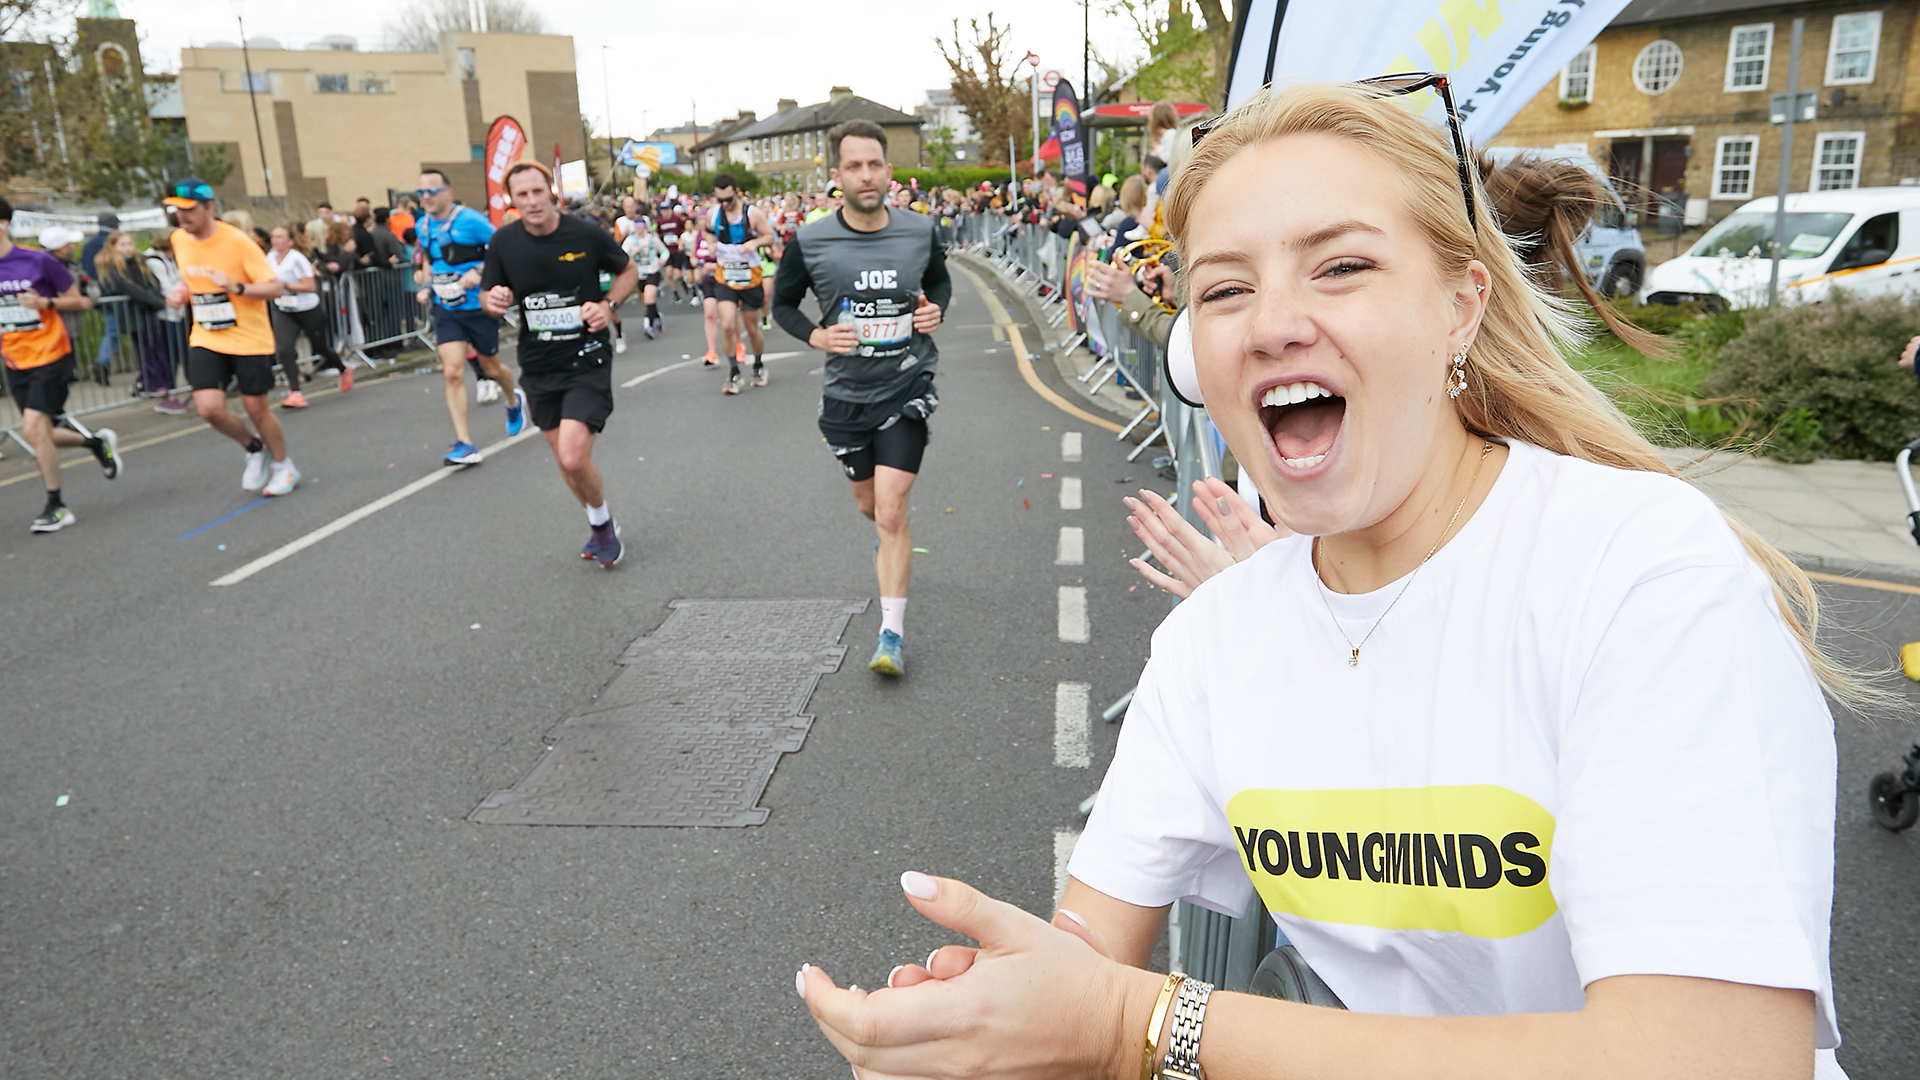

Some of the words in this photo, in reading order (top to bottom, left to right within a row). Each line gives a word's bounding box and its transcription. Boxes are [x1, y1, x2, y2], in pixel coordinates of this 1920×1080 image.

[1475, 10, 1572, 95] young
[0, 279, 32, 292] nse
[854, 269, 898, 291] JOE
[850, 299, 876, 317] tcs
[535, 312, 574, 327] 50240
[862, 321, 899, 339] 8777
[1233, 824, 1547, 889] YOUNGMINDS
